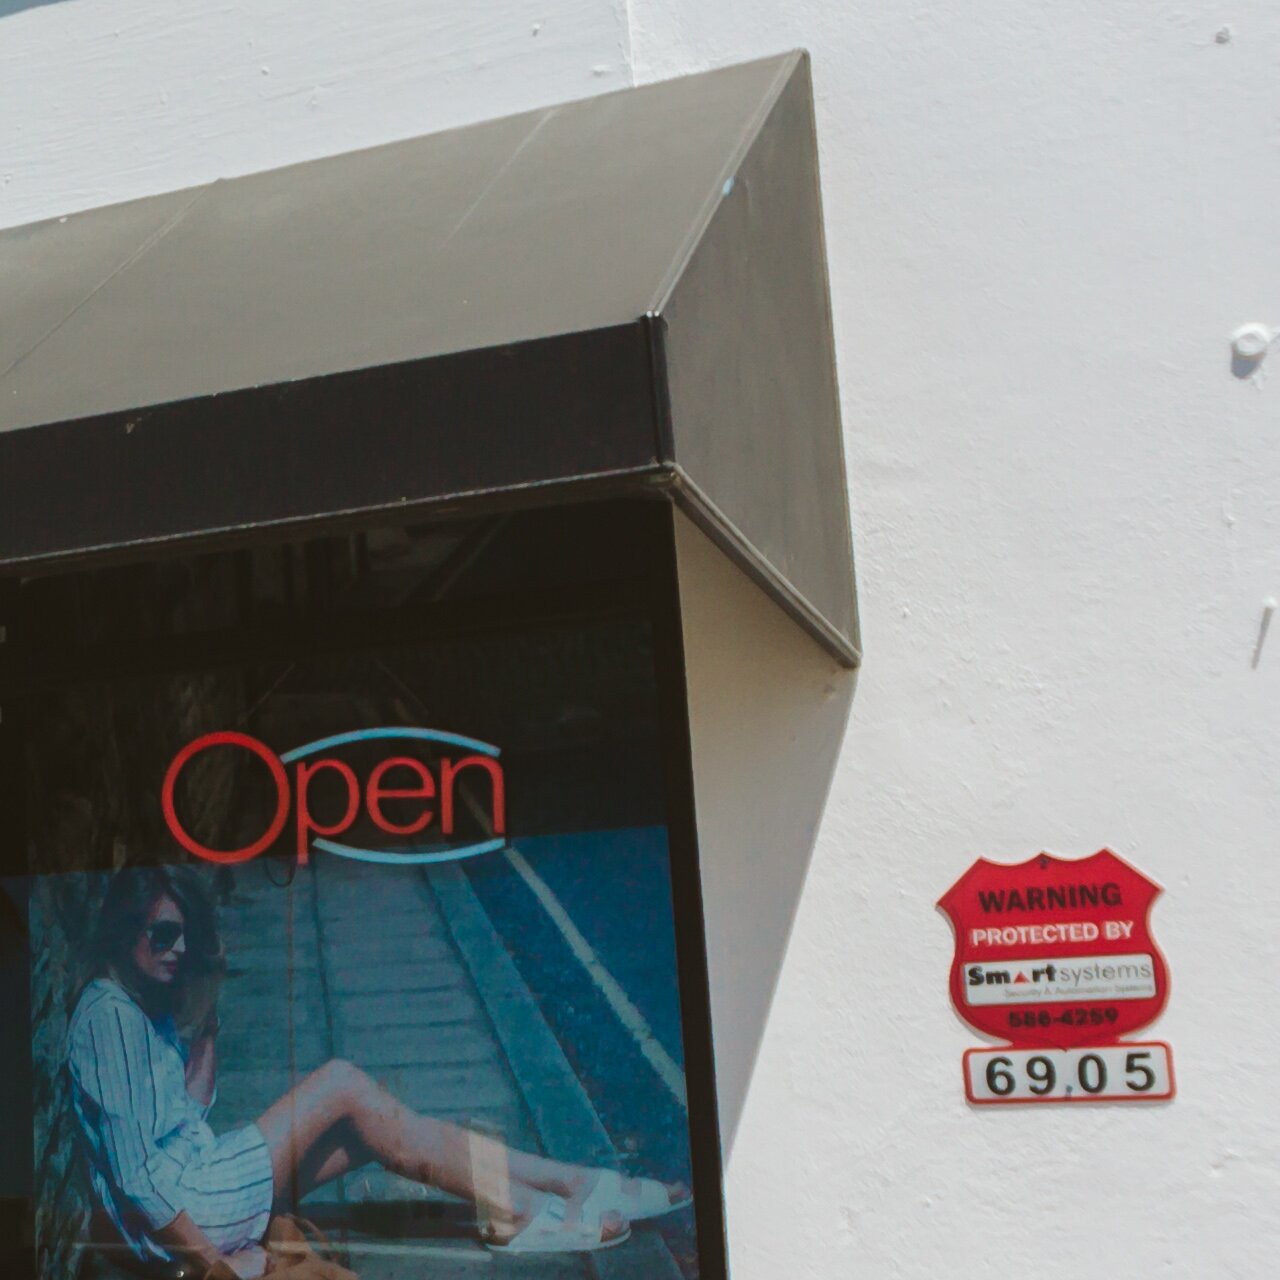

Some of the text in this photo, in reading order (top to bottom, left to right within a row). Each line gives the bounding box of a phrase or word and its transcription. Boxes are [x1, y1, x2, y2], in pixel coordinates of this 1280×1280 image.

[161, 730, 506, 865] Open
[978, 882, 1123, 914] WARNING
[972, 921, 1134, 946] PROTECTED BY
